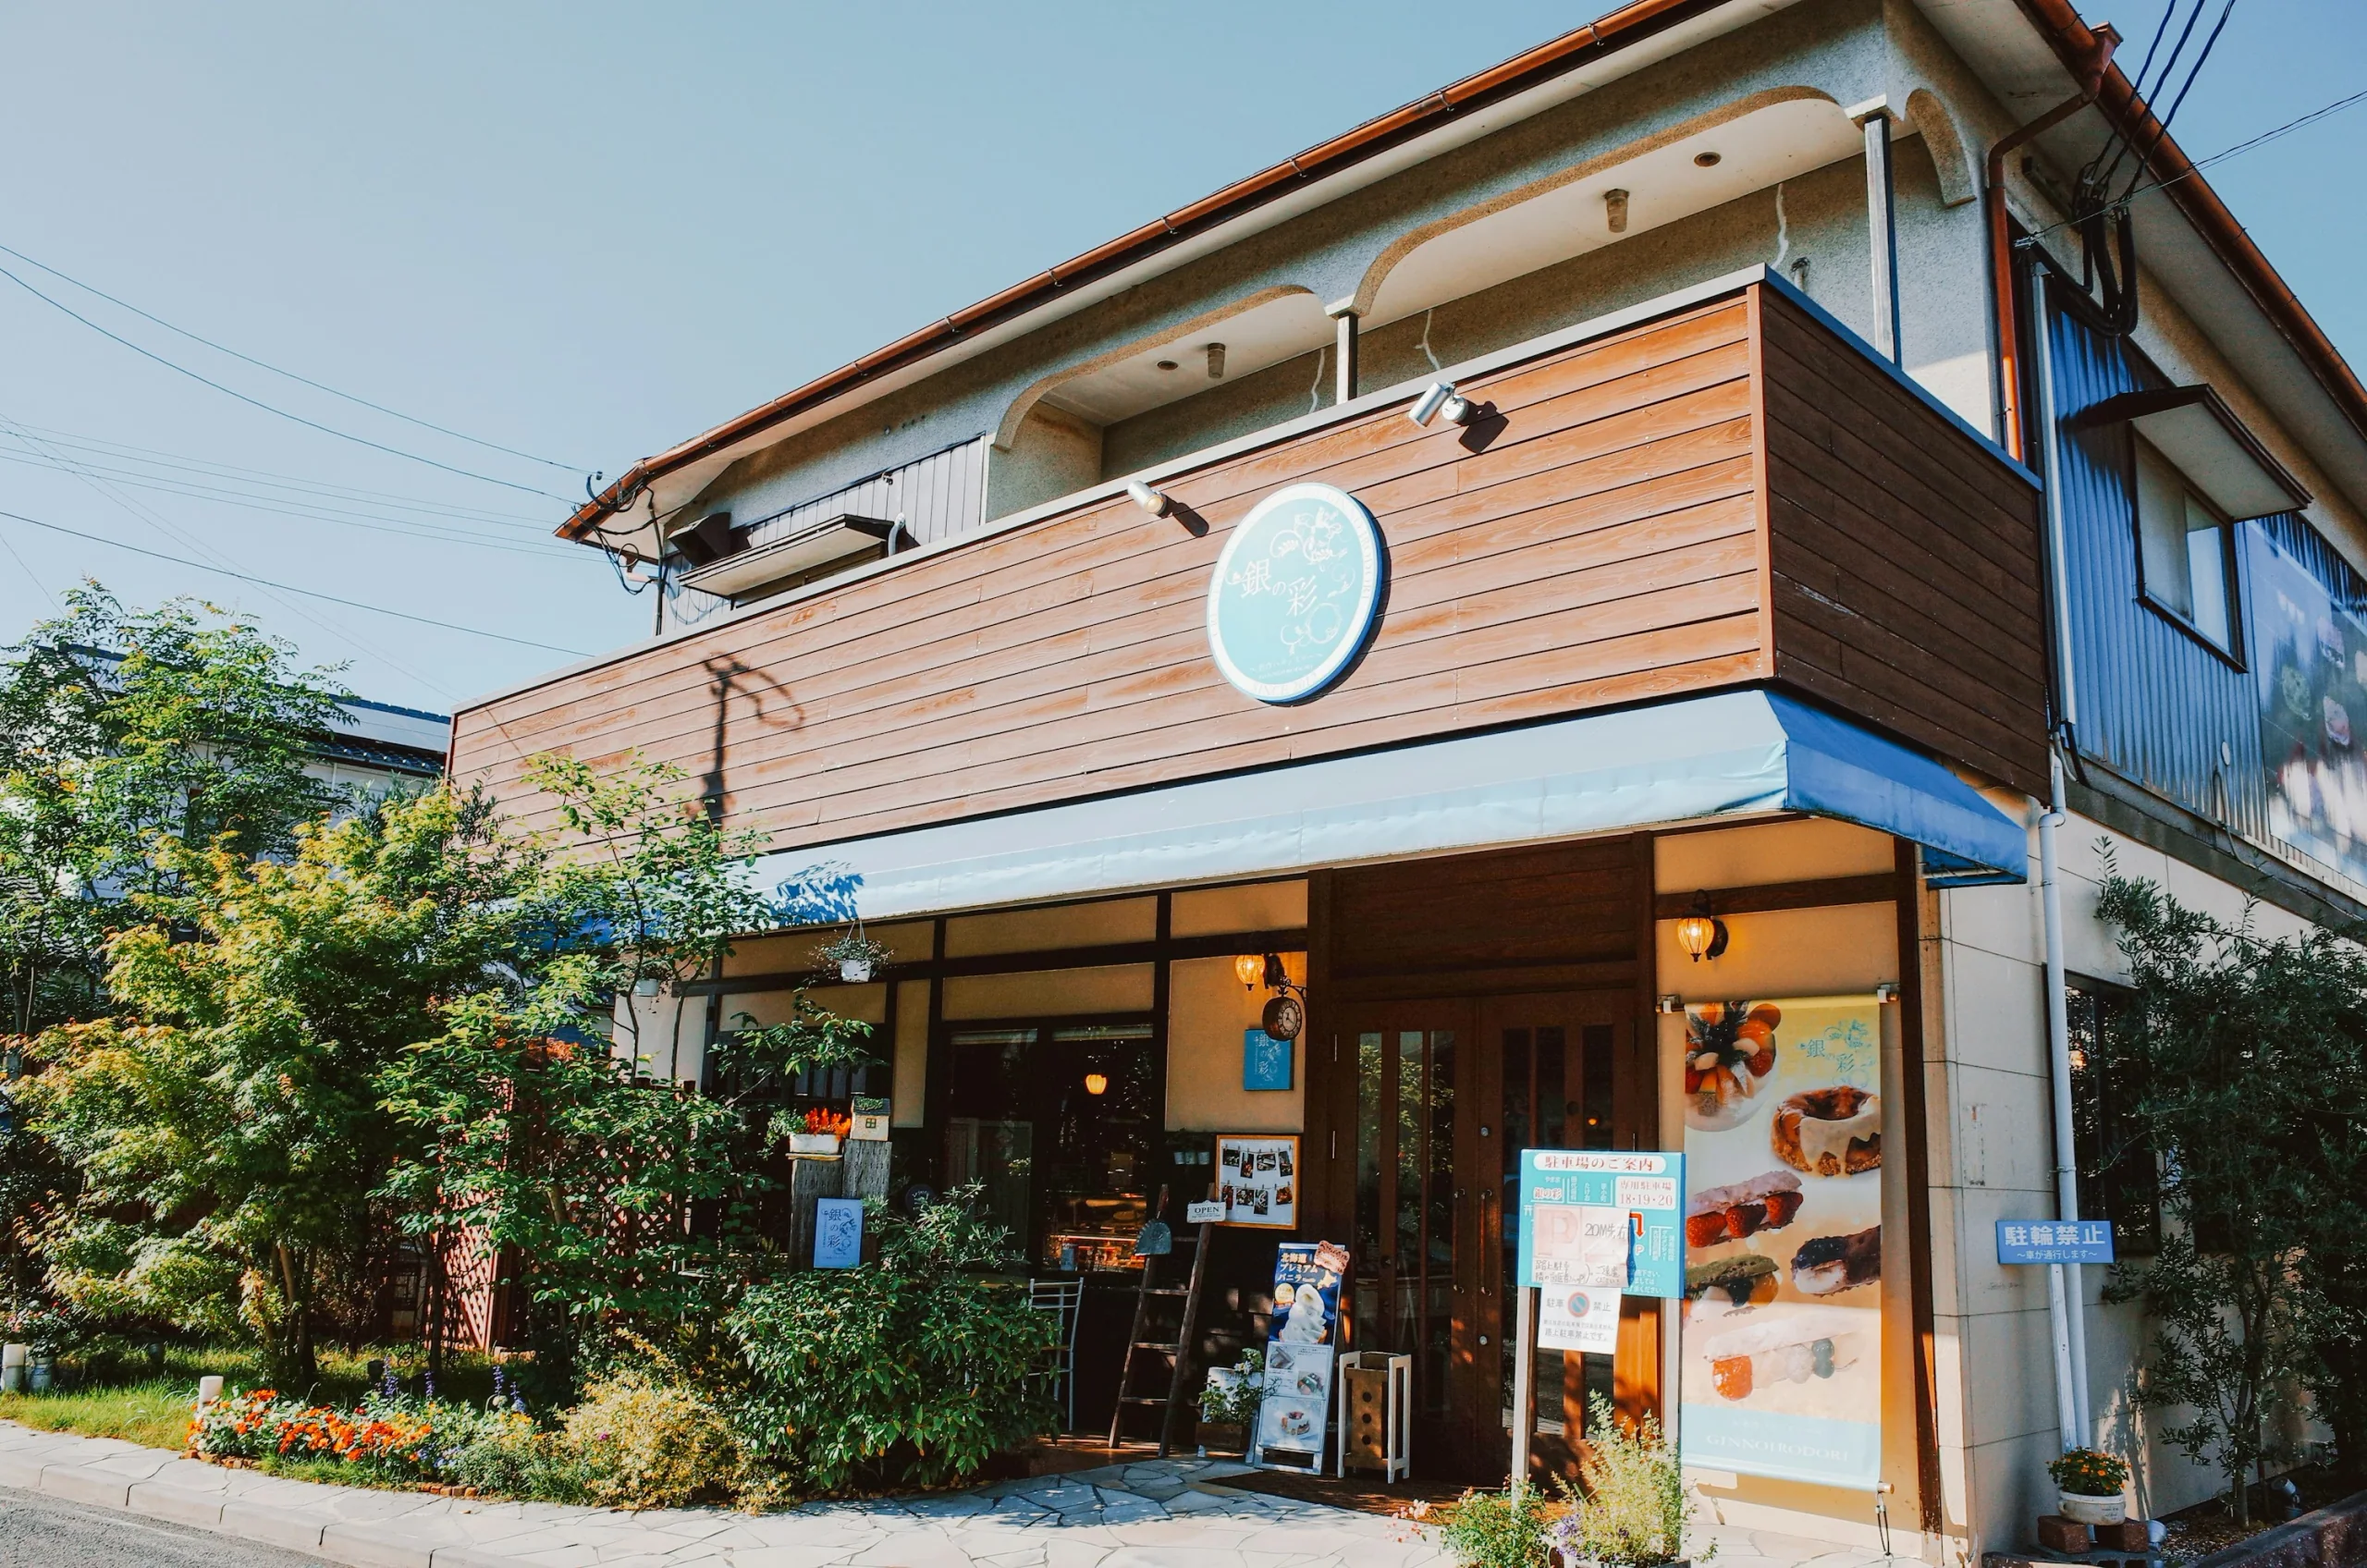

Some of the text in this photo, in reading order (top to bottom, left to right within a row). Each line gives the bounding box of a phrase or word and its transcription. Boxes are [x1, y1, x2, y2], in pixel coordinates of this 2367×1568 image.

[1240, 558, 1318, 617] 銀の彩
[1544, 1156, 1653, 1171] 駐車場のご案内
[1620, 1181, 1672, 1191] 専用駐車場
[1194, 1206, 1220, 1214] OPEN
[828, 1208, 841, 1248] 銀の彩
[2005, 1224, 2105, 1246] 駐輪禁止
[1636, 1244, 1644, 1256] P
[1281, 1253, 1307, 1263] 北海道
[1280, 1264, 1318, 1273] プレミアム
[1277, 1274, 1302, 1282] バニラ
[1546, 1298, 1611, 1312] 駐車 禁止
